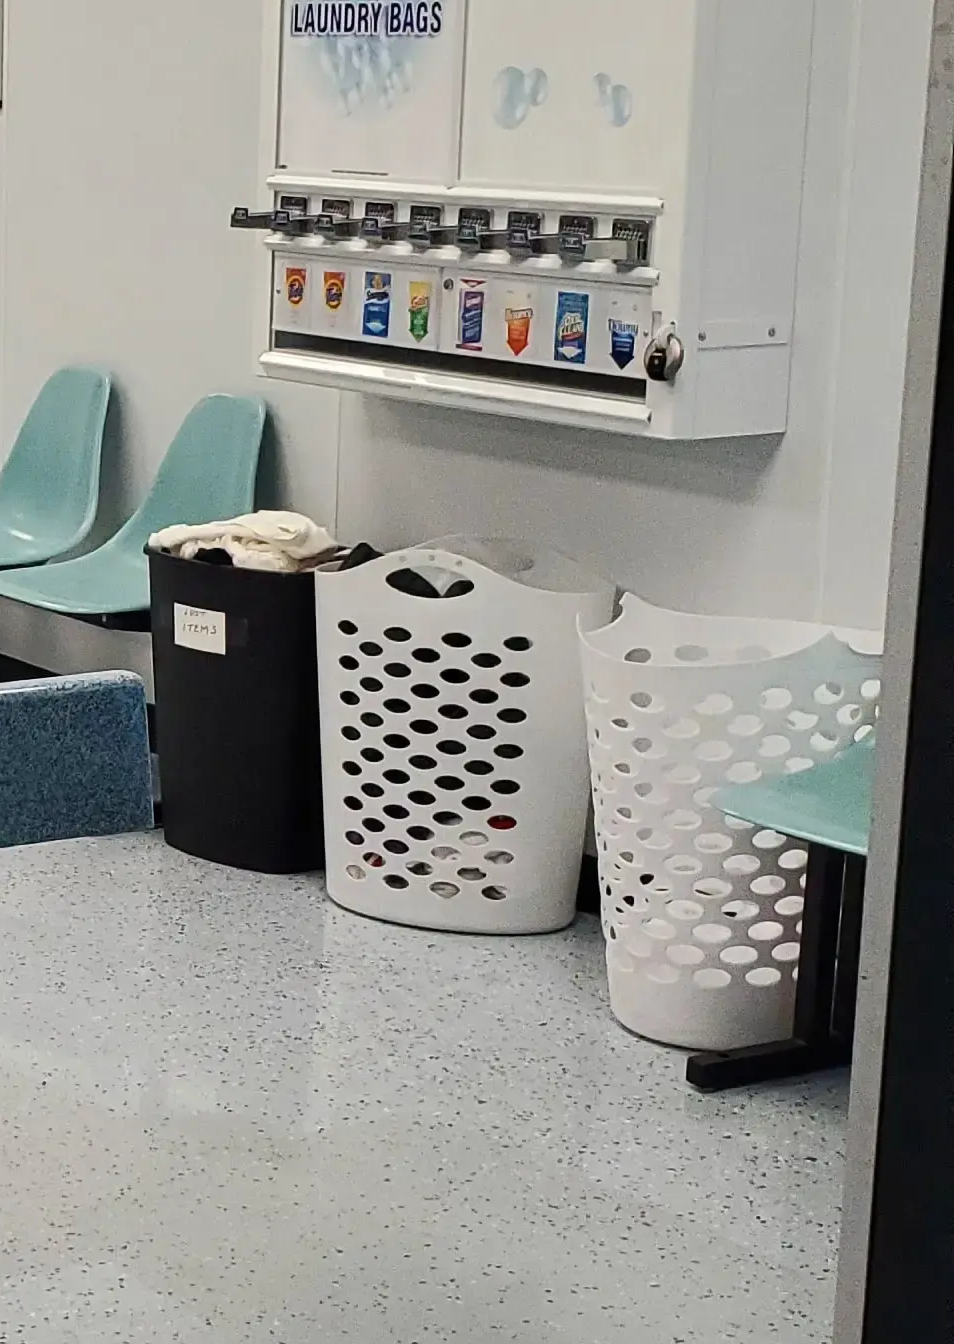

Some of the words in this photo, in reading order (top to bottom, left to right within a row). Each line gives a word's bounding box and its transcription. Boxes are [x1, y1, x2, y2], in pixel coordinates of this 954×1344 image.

[294, 3, 383, 34] LAUNDRY
[389, 1, 442, 33] BAGS
[182, 623, 217, 636] ITEMS
